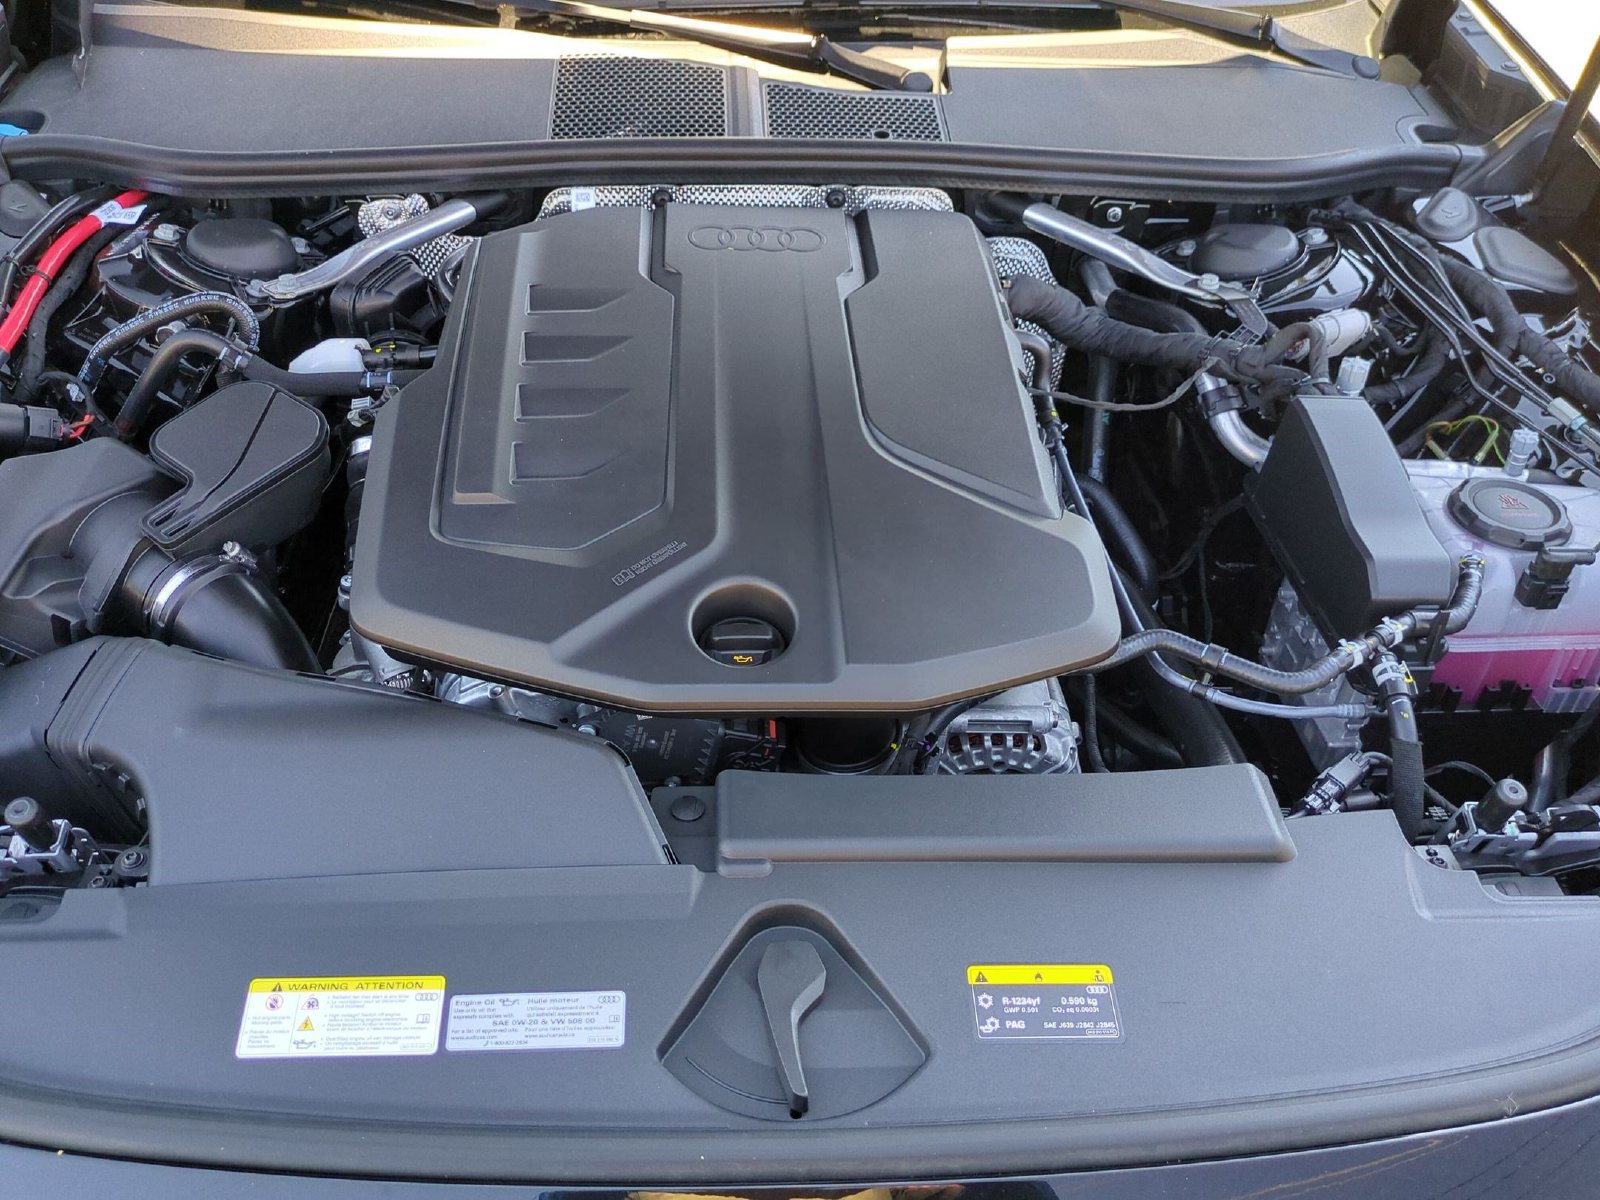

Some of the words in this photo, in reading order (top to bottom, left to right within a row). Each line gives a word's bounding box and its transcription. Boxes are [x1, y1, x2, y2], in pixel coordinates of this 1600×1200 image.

[288, 983, 348, 991] WARNING
[355, 982, 424, 990] ATTENTION
[1002, 996, 1041, 1007] R-1234yf
[1060, 996, 1085, 1005] 0.590
[1087, 996, 1098, 1006] kg
[1006, 1020, 1026, 1029] PAG
